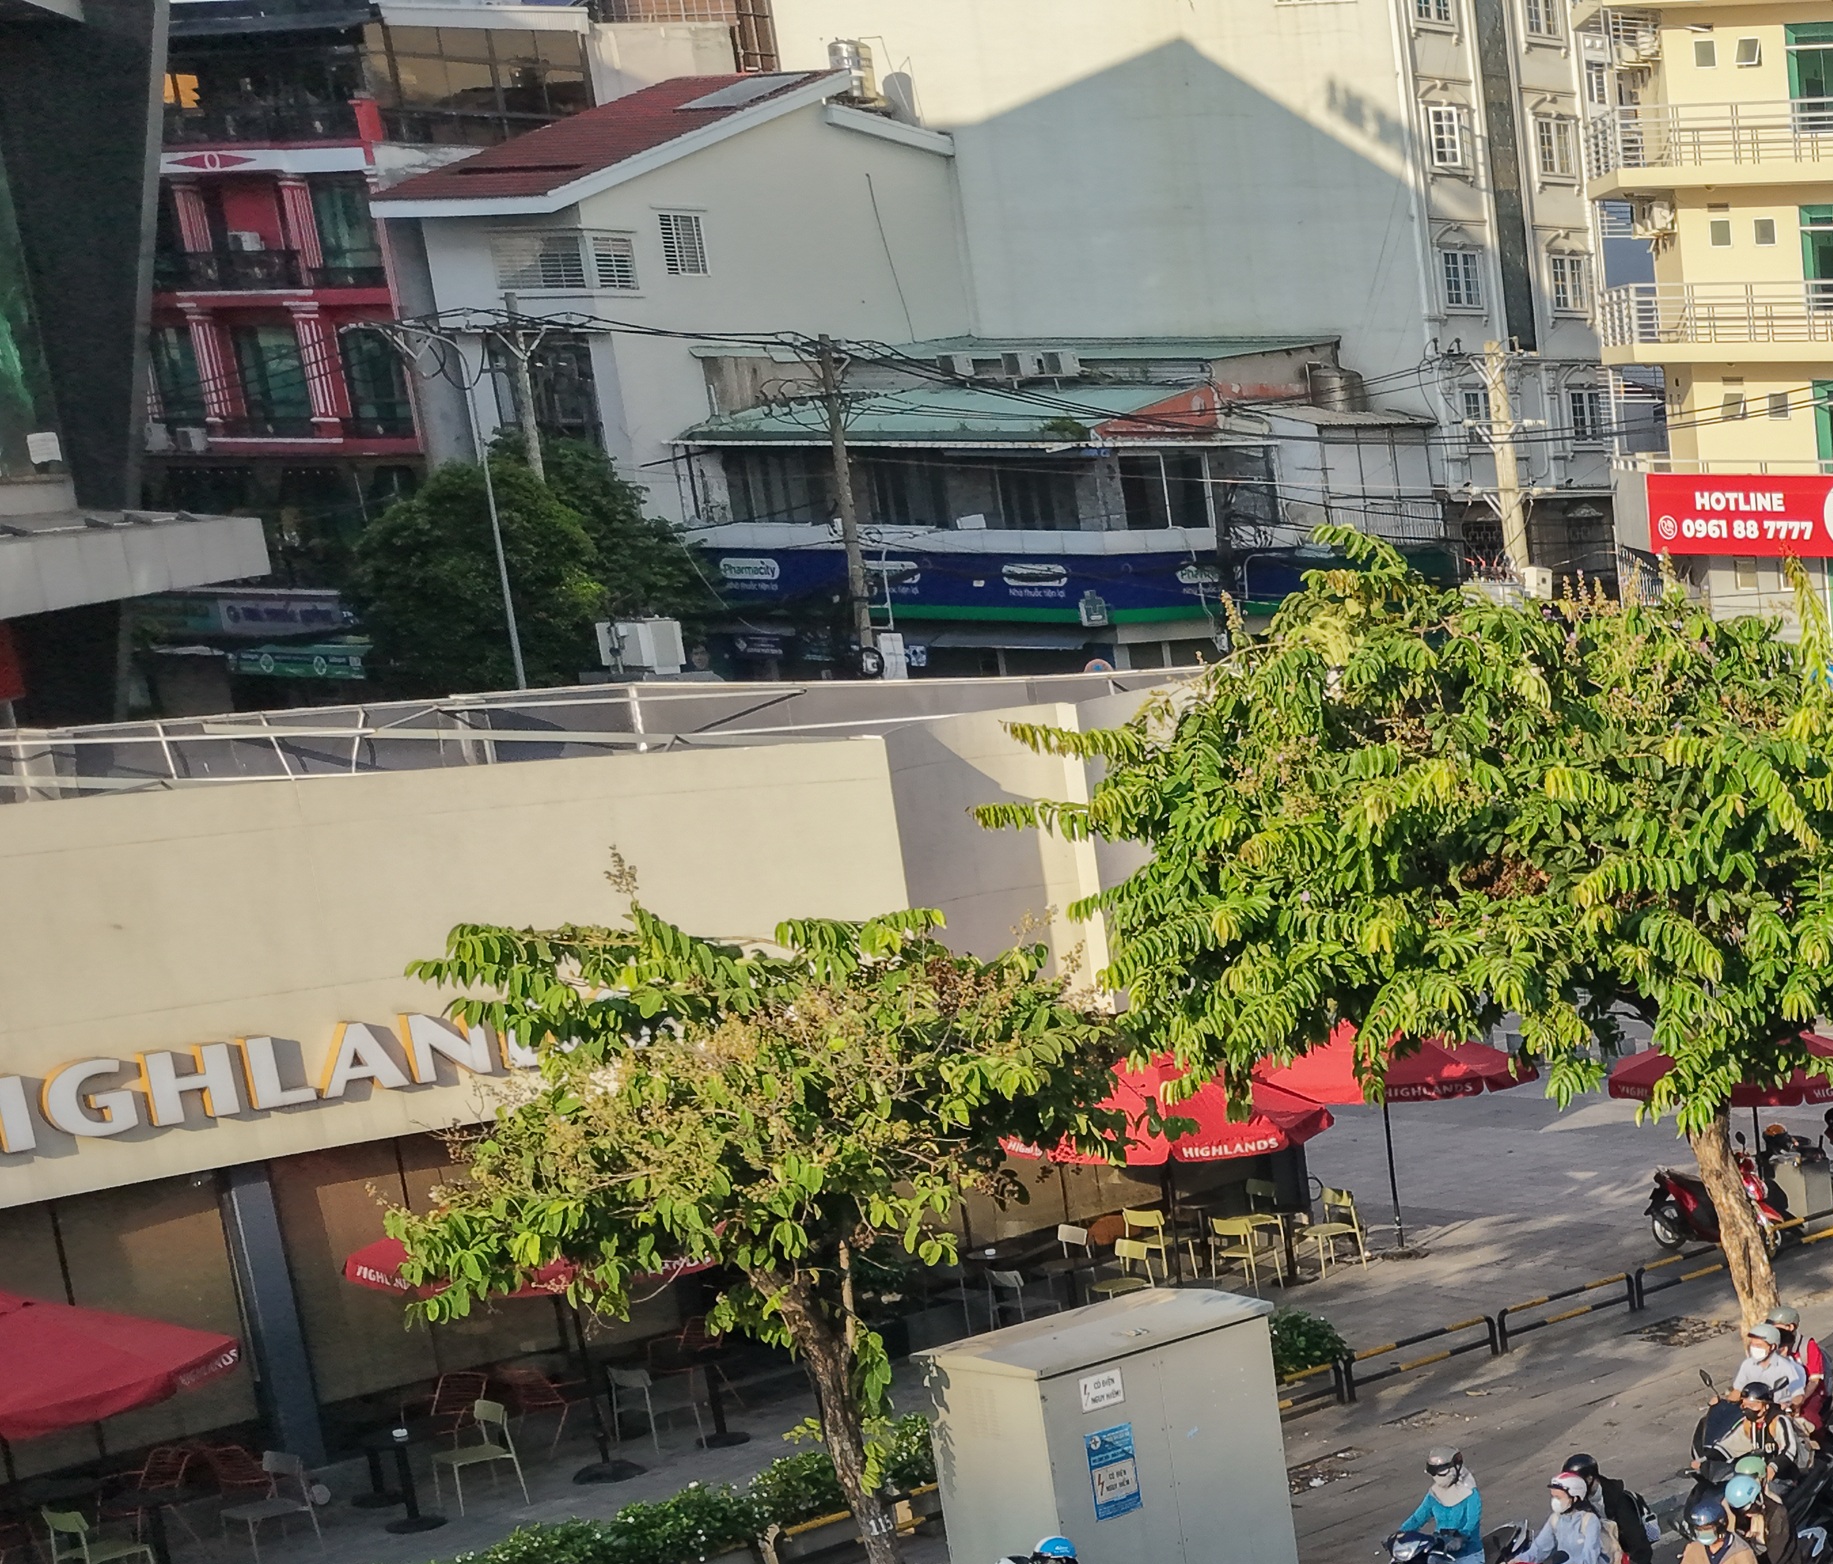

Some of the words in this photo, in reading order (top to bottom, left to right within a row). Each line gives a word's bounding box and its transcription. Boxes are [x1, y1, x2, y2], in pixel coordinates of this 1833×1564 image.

[1694, 491, 1785, 513] HOTLINE
[1682, 519, 1728, 538] 0961
[1733, 519, 1759, 540] 88
[1763, 520, 1813, 541] 7777
[723, 561, 776, 578] Pharmacity
[0, 1012, 541, 1154] IGHLAND
[1386, 1081, 1473, 1098] HIGHLANDS
[1183, 1138, 1278, 1158] HIGHLANDS
[1093, 1378, 1102, 1390] CÓ
[1102, 1376, 1116, 1389] ĐIỆN
[1091, 1394, 1106, 1405] NGUY
